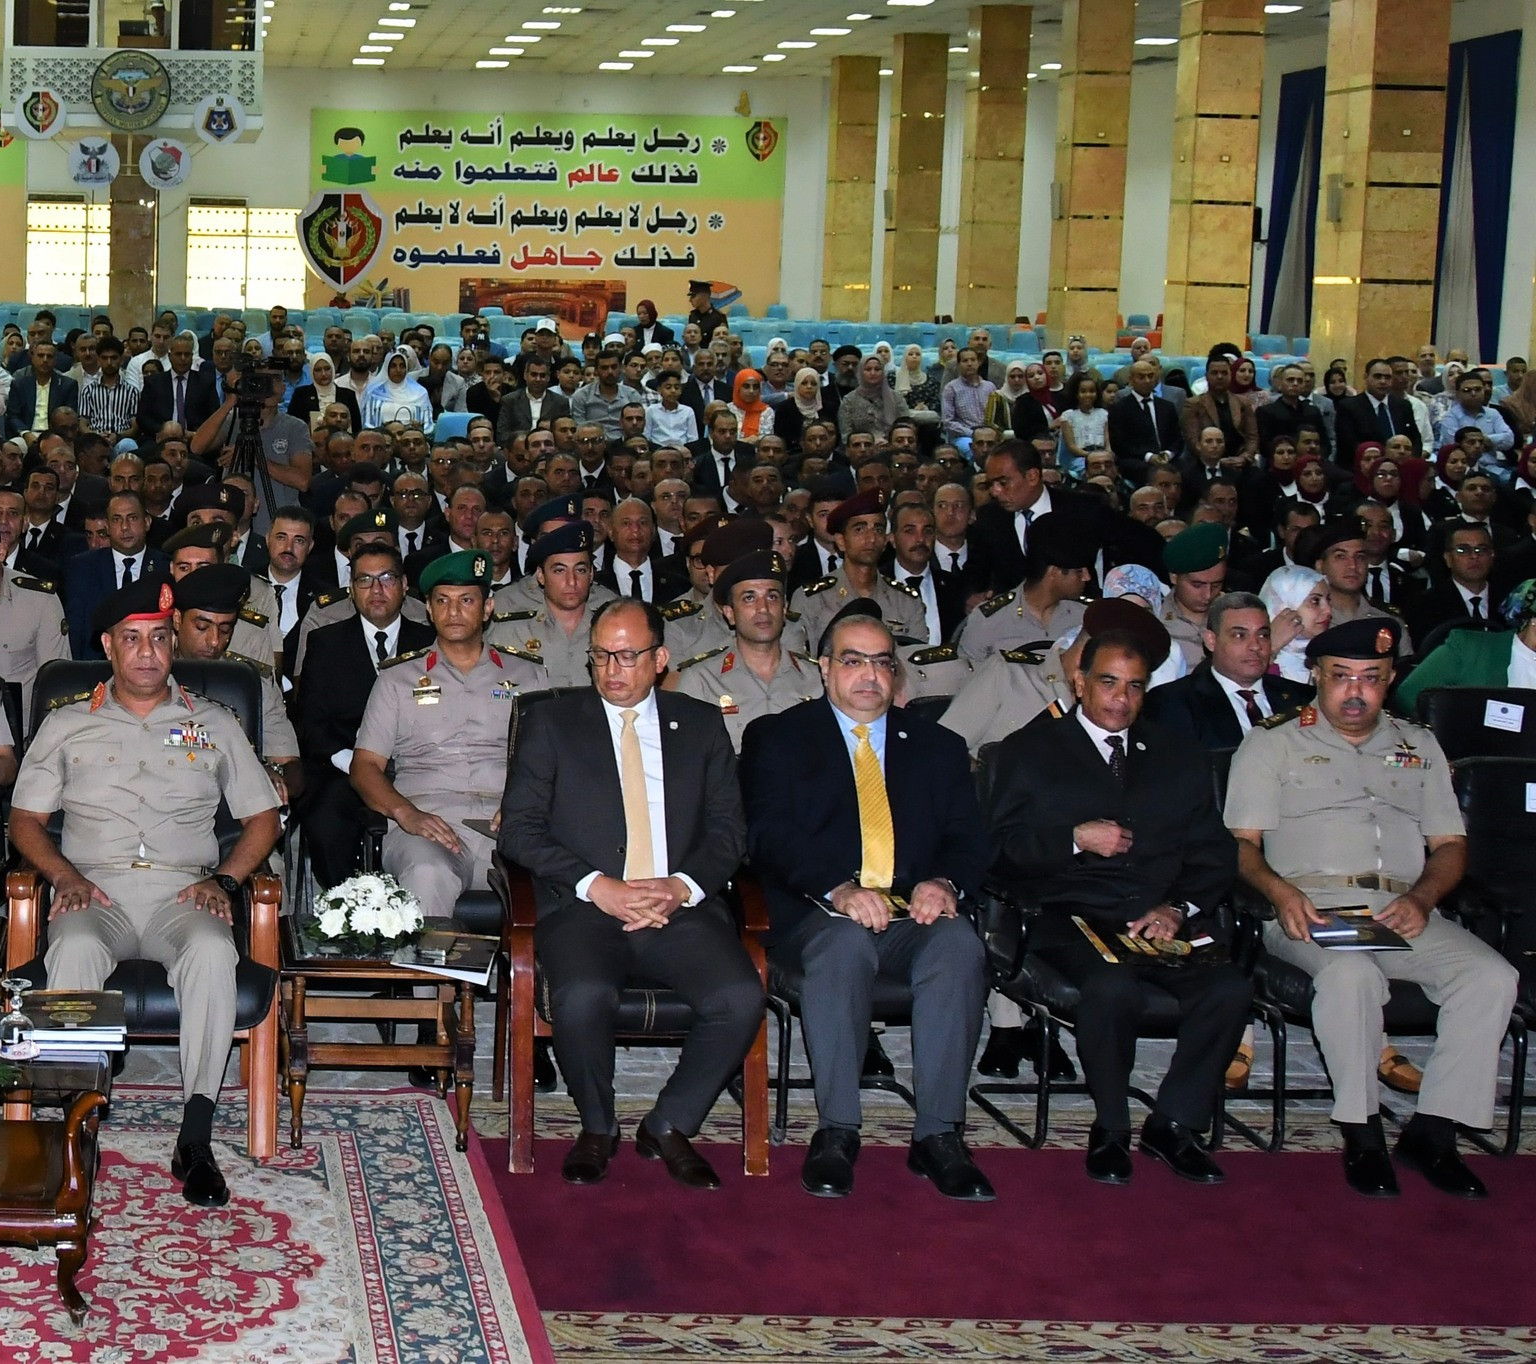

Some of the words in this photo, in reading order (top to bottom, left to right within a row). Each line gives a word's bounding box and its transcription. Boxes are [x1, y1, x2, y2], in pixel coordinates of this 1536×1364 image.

[399, 123, 453, 151] يعلم
[460, 117, 502, 147] أنه
[509, 125, 575, 154] ويعلم
[582, 126, 636, 155] يعلم
[643, 127, 701, 154] رجل
[393, 161, 442, 181] منه
[455, 160, 558, 185] فتعلموا
[567, 163, 620, 189] عالم
[631, 162, 699, 185] فذلك
[395, 201, 443, 233] يعلم
[449, 200, 460, 225] لا
[466, 195, 504, 227] أنه
[510, 203, 568, 234] ويعلم
[575, 204, 623, 236] يعلم
[629, 204, 640, 228] لا
[646, 204, 698, 235] رجل
[392, 243, 501, 270] فعلموه
[510, 243, 604, 272] جاهل
[613, 246, 696, 268] فذلك
